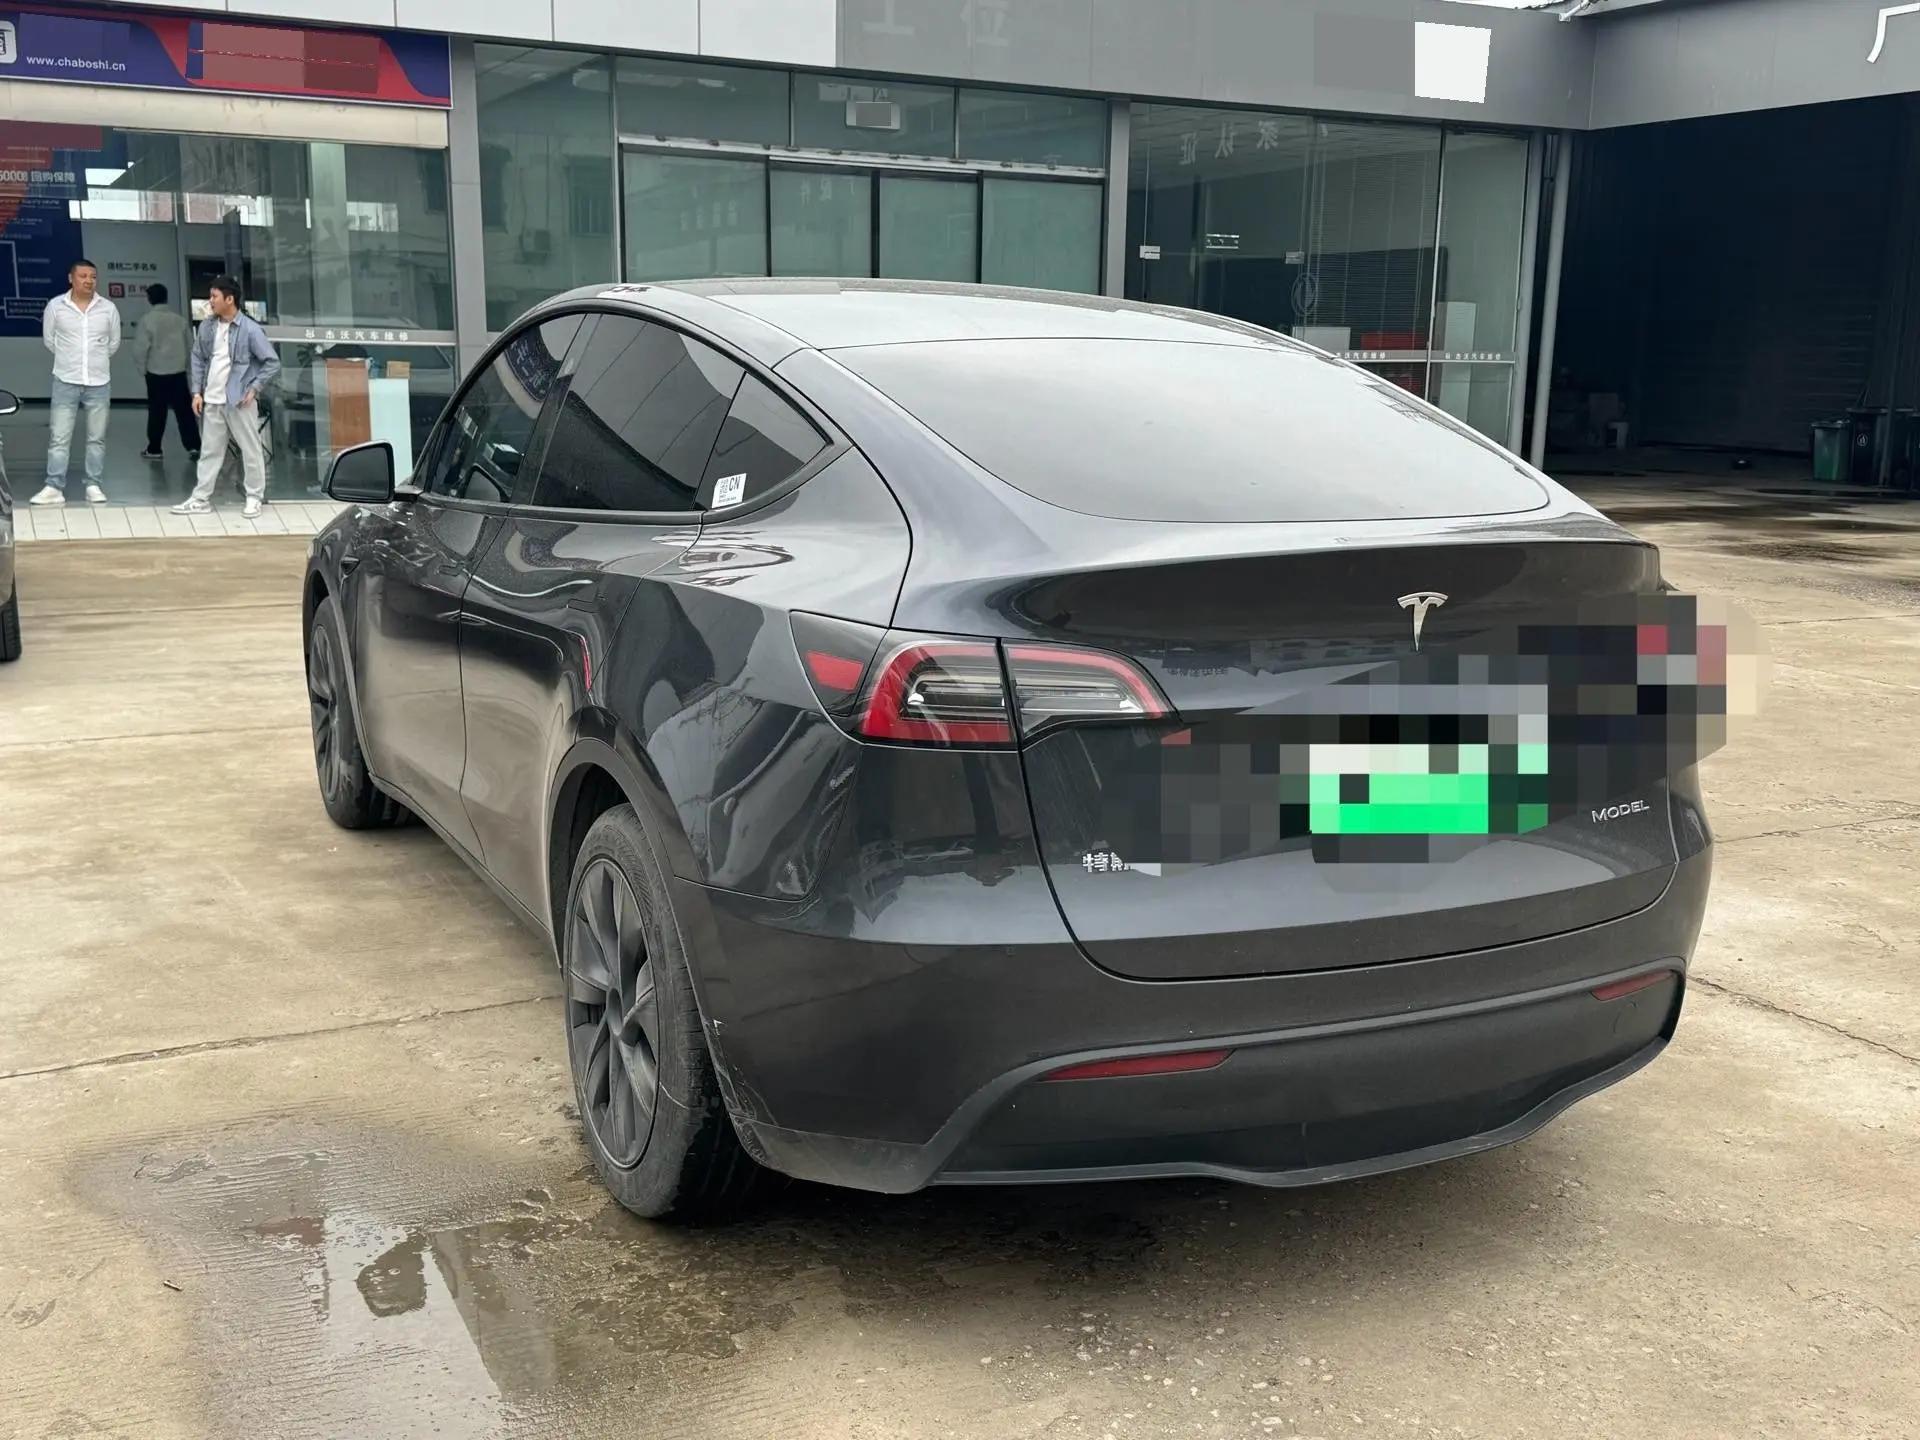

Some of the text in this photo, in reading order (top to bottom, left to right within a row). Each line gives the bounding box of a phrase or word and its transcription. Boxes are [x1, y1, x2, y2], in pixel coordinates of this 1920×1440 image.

[26, 56, 126, 71] www.chaboshi.cn
[728, 475, 742, 491] CN
[1591, 799, 1650, 823] MODEL
